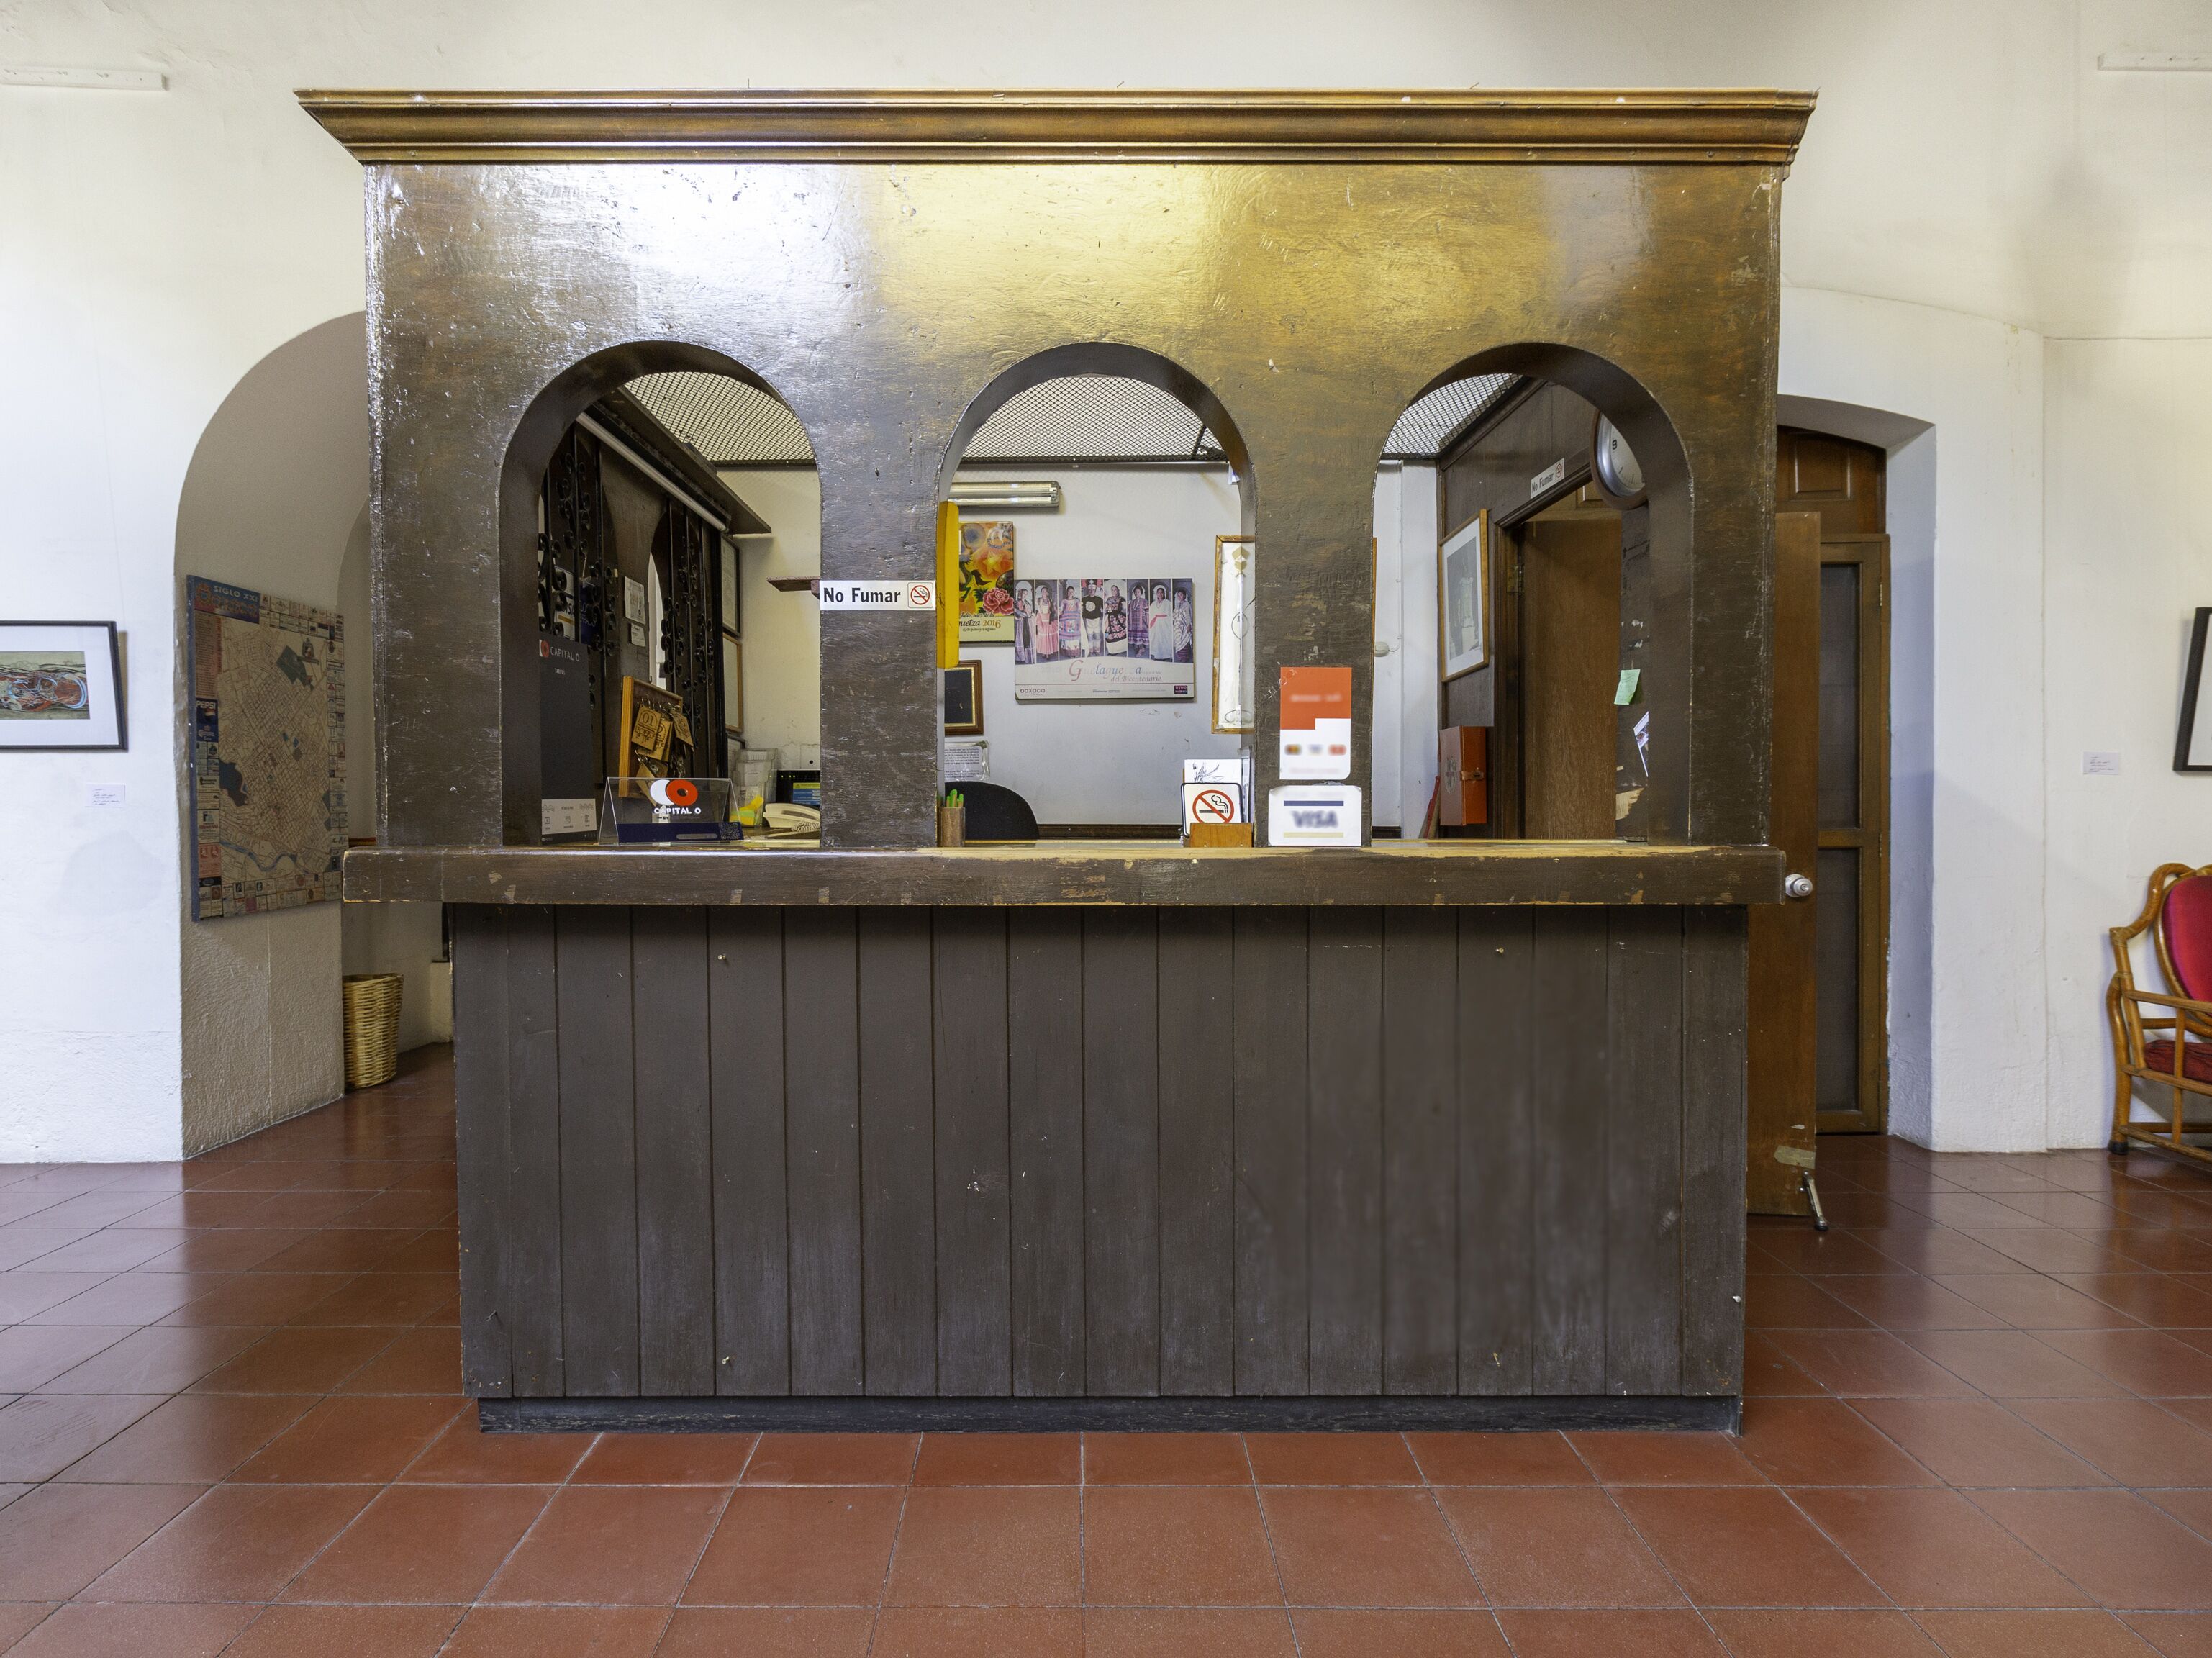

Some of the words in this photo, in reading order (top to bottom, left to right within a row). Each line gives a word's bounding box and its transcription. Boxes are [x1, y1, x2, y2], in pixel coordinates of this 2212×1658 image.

[1532, 481, 1538, 491] No
[1539, 473, 1554, 489] Fumar
[212, 585, 241, 597] SIGLO
[243, 593, 258, 602] XXI
[823, 587, 844, 603] No
[851, 587, 901, 603] Fumar
[982, 620, 1002, 628] 2016
[550, 646, 575, 661] CAPITAL
[576, 653, 580, 662] O
[196, 700, 217, 710] PEPSI
